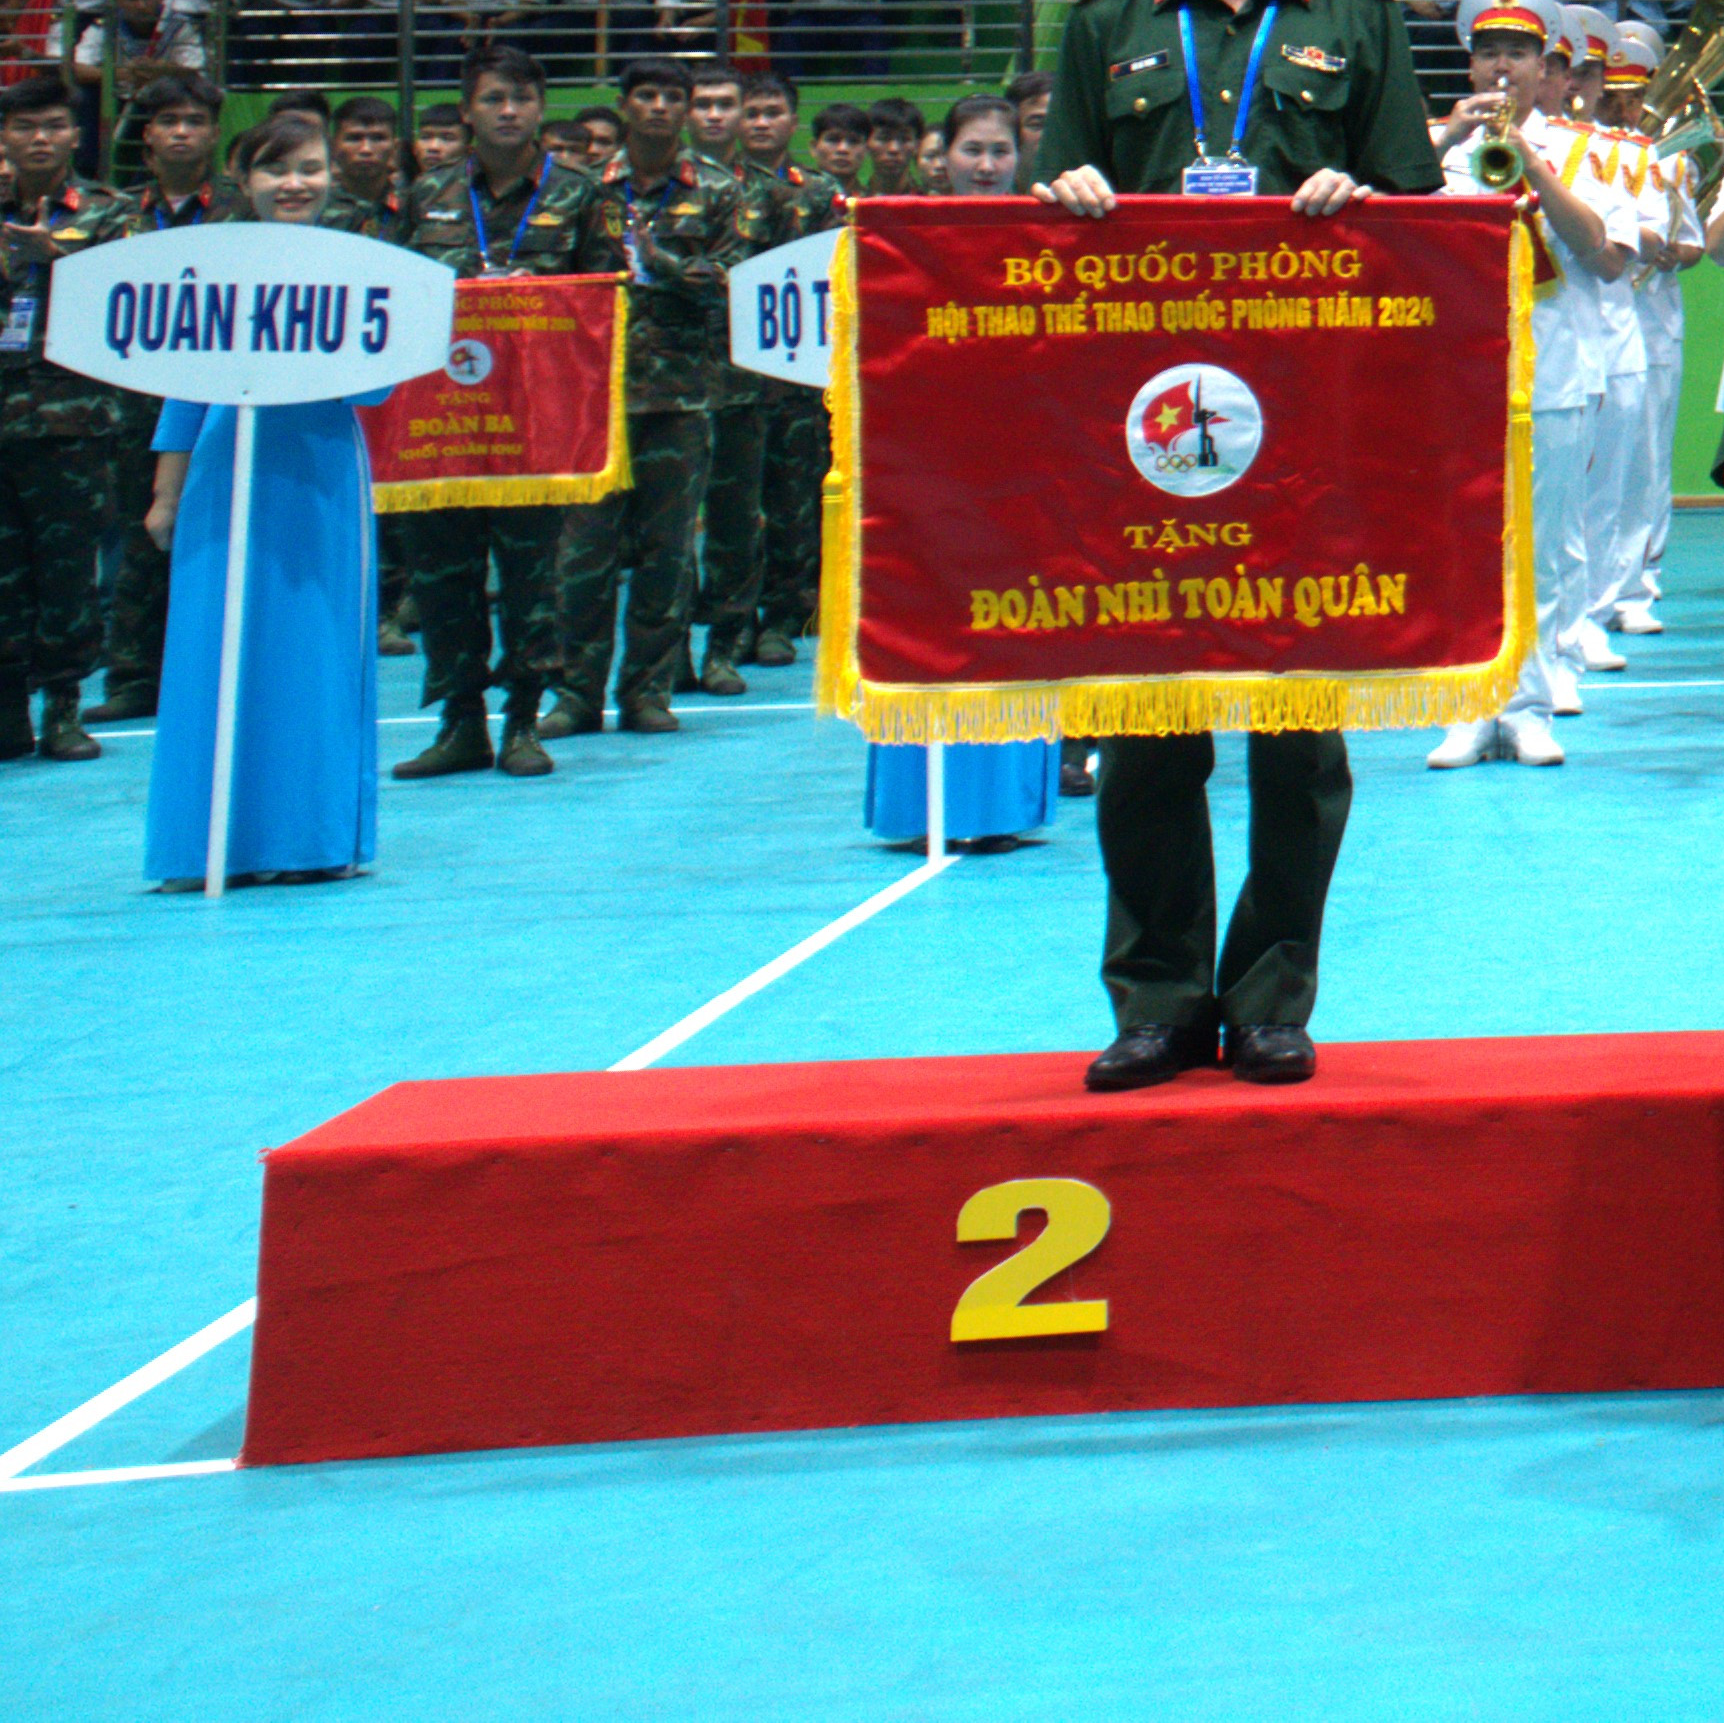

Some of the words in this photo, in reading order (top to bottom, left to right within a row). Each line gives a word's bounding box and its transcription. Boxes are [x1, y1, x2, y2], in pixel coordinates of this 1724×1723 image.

[1003, 250, 1062, 288] BỘ
[1074, 241, 1197, 289] QUỐC
[1210, 248, 1362, 281] PHÒNG
[105, 266, 238, 359] QUÂN
[250, 283, 348, 354] KHU
[360, 286, 391, 355] 5
[757, 266, 803, 362] BỘ
[928, 302, 969, 344] HỘI
[973, 304, 1036, 337] THAO
[1043, 291, 1089, 335] THỂ
[1093, 302, 1155, 333] THAO
[1161, 290, 1225, 335] QUỐC
[1231, 299, 1311, 329] PHÒNG
[1318, 296, 1371, 328] NĂM
[1378, 297, 1435, 327] 2024
[484, 414, 515, 433] BA
[1124, 519, 1252, 554] TẶNG
[970, 576, 1086, 630] ĐOÀN
[1096, 570, 1172, 623] NHÌ
[1179, 565, 1285, 620] TOÀN
[1293, 565, 1407, 626] QUÂN
[951, 1178, 1110, 1342] 2
